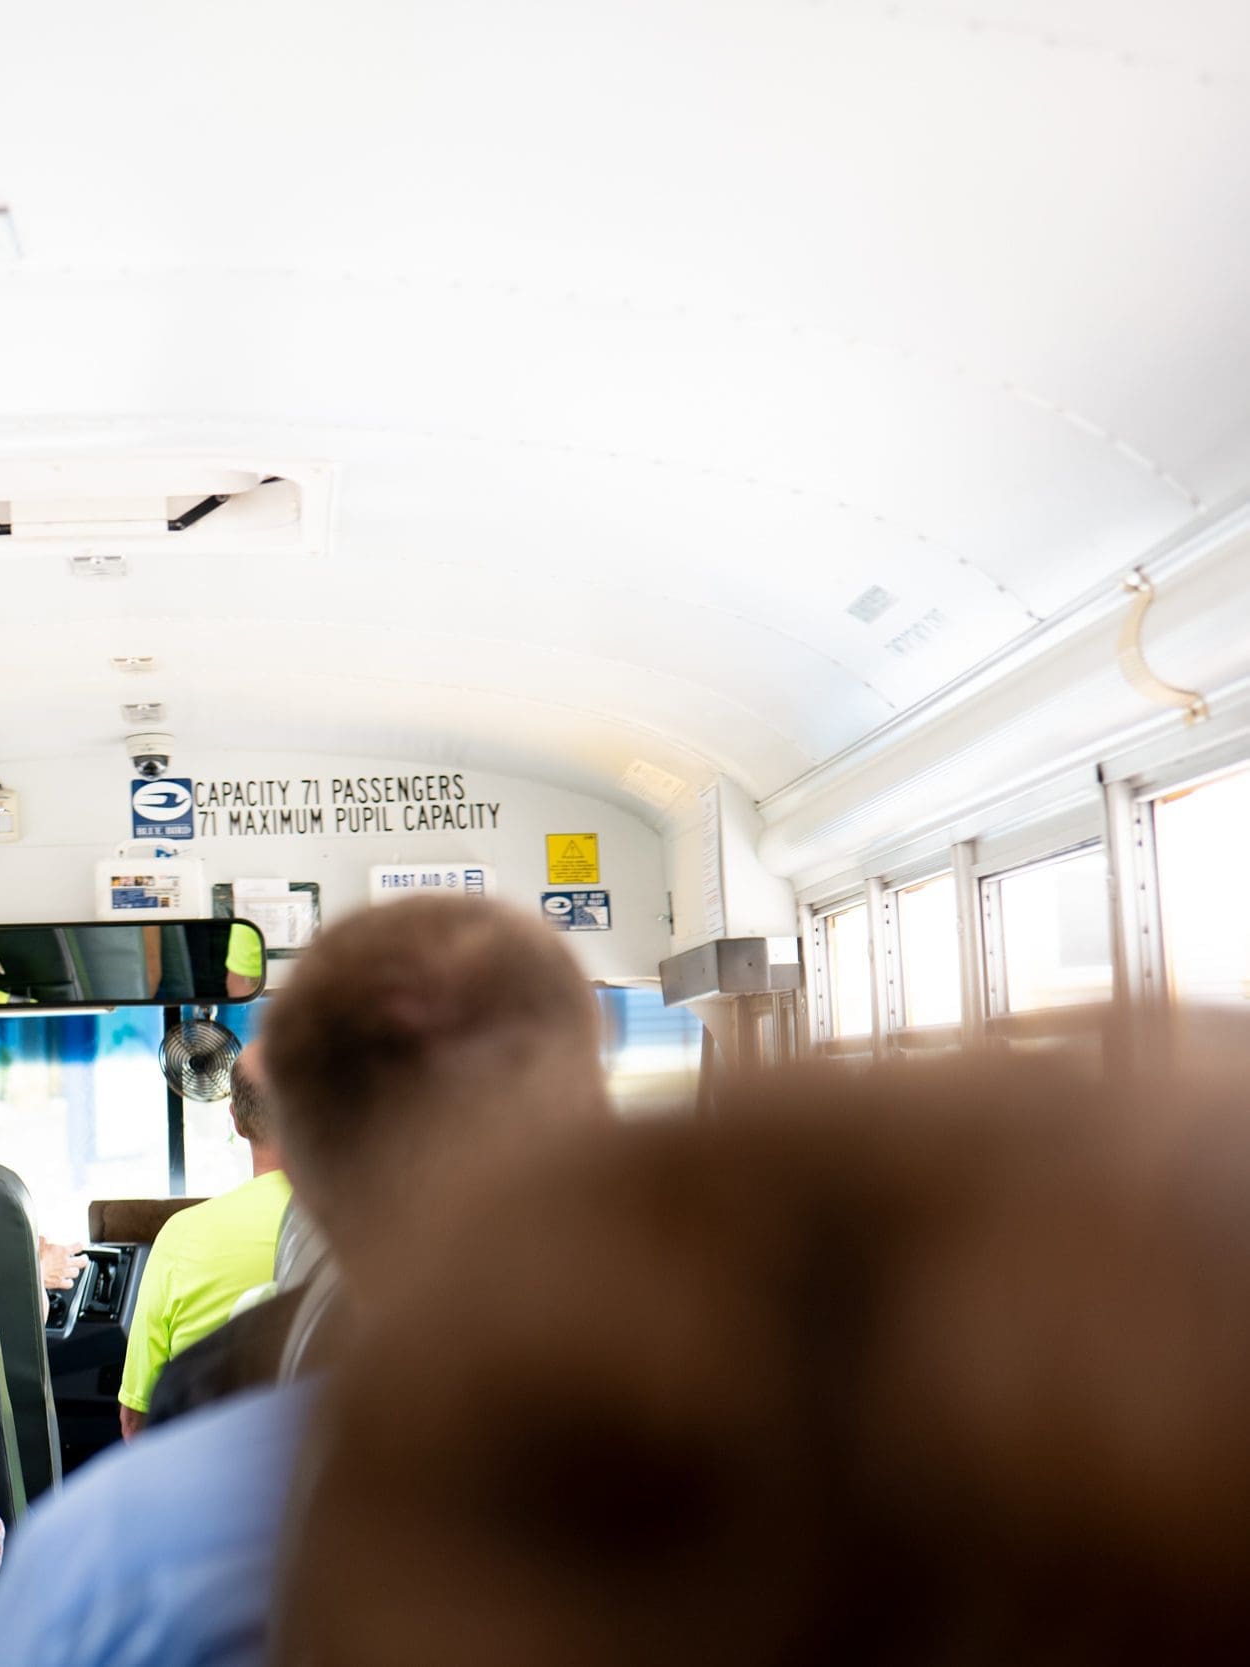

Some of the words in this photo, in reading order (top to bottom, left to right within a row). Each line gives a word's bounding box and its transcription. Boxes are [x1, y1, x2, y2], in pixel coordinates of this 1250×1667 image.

[194, 780, 290, 807] CAPACITY
[301, 779, 320, 805] 71
[332, 774, 465, 803] PASSENGERS
[198, 811, 217, 836] 71
[229, 808, 323, 835] MAXIMUM
[335, 806, 393, 833] PUPIL
[403, 803, 500, 831] CAPACITY
[381, 874, 415, 888] FIRST
[420, 873, 442, 887] AID
